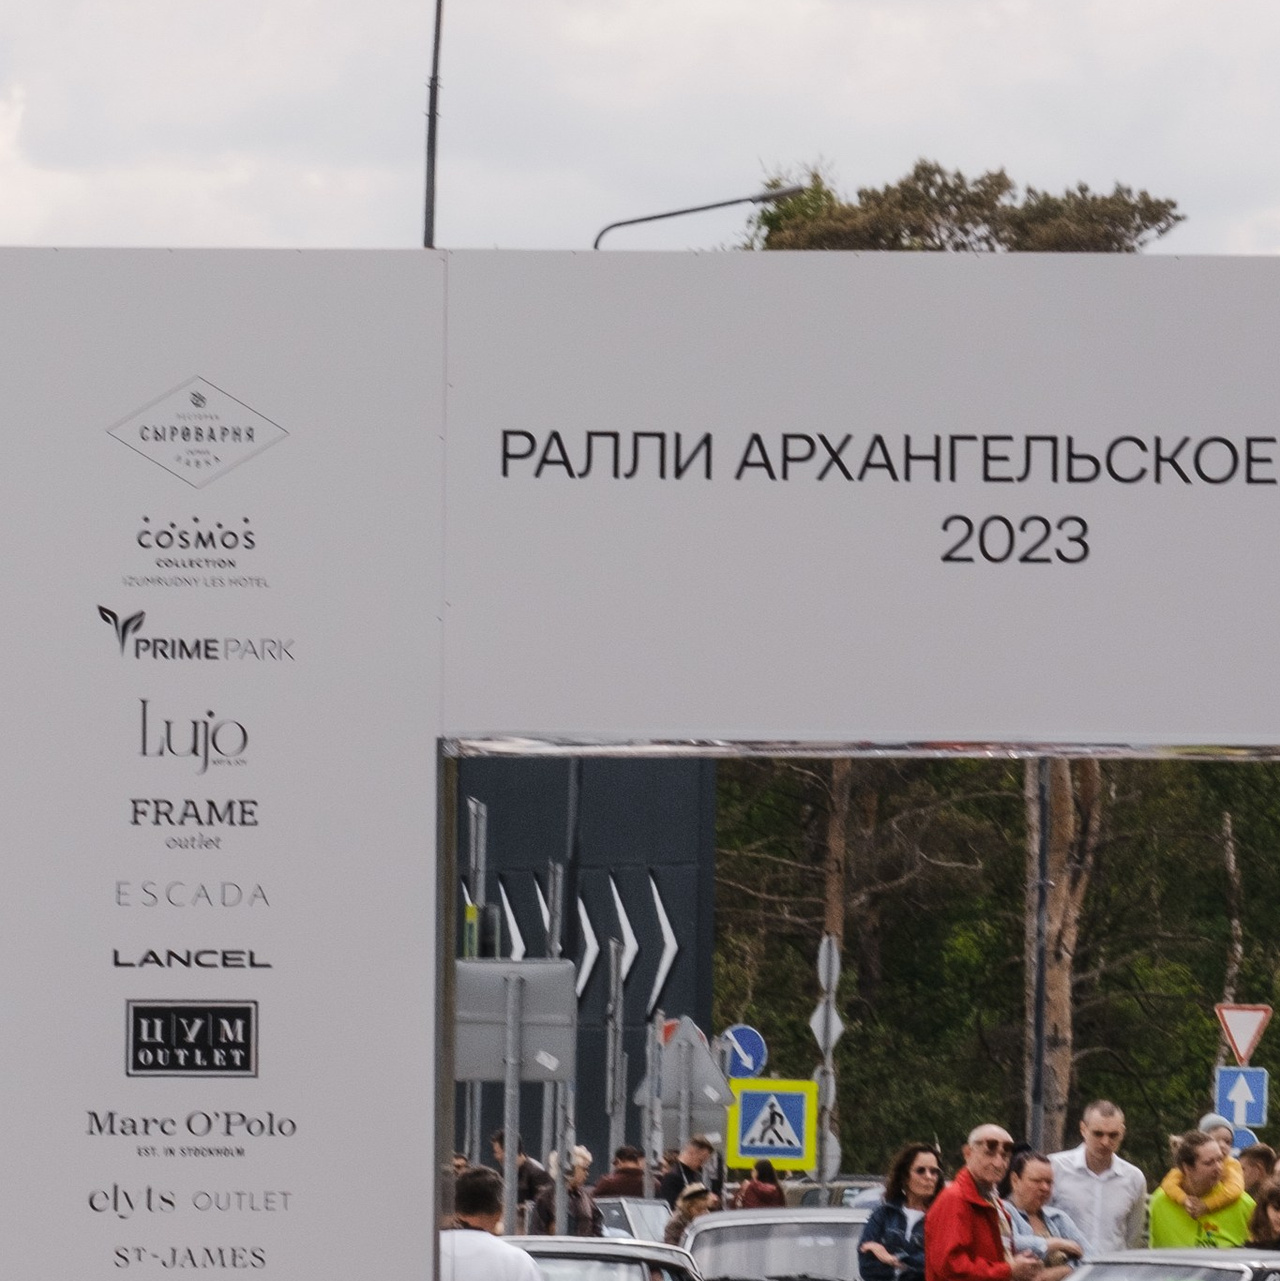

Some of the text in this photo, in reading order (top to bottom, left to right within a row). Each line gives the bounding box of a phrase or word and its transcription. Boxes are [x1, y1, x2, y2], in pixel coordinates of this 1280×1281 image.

[139, 425, 254, 442] СЫРОВАРНЯ
[501, 429, 713, 480] РАЛЛИ
[734, 432, 1278, 485] АРХАНГЕЛЬСКОЕ
[137, 530, 256, 550] COSMOS
[941, 514, 1090, 564] 2023
[155, 558, 236, 569] COLLECTION
[138, 697, 249, 775] Lujo
[130, 799, 259, 826] FRAME
[165, 832, 222, 850] outlet
[115, 881, 270, 907] ESCADA
[113, 949, 272, 969] LANCEL
[137, 1048, 245, 1067] OUTLET
[87, 1111, 176, 1136] Marc
[192, 1191, 292, 1211] OUTLET
